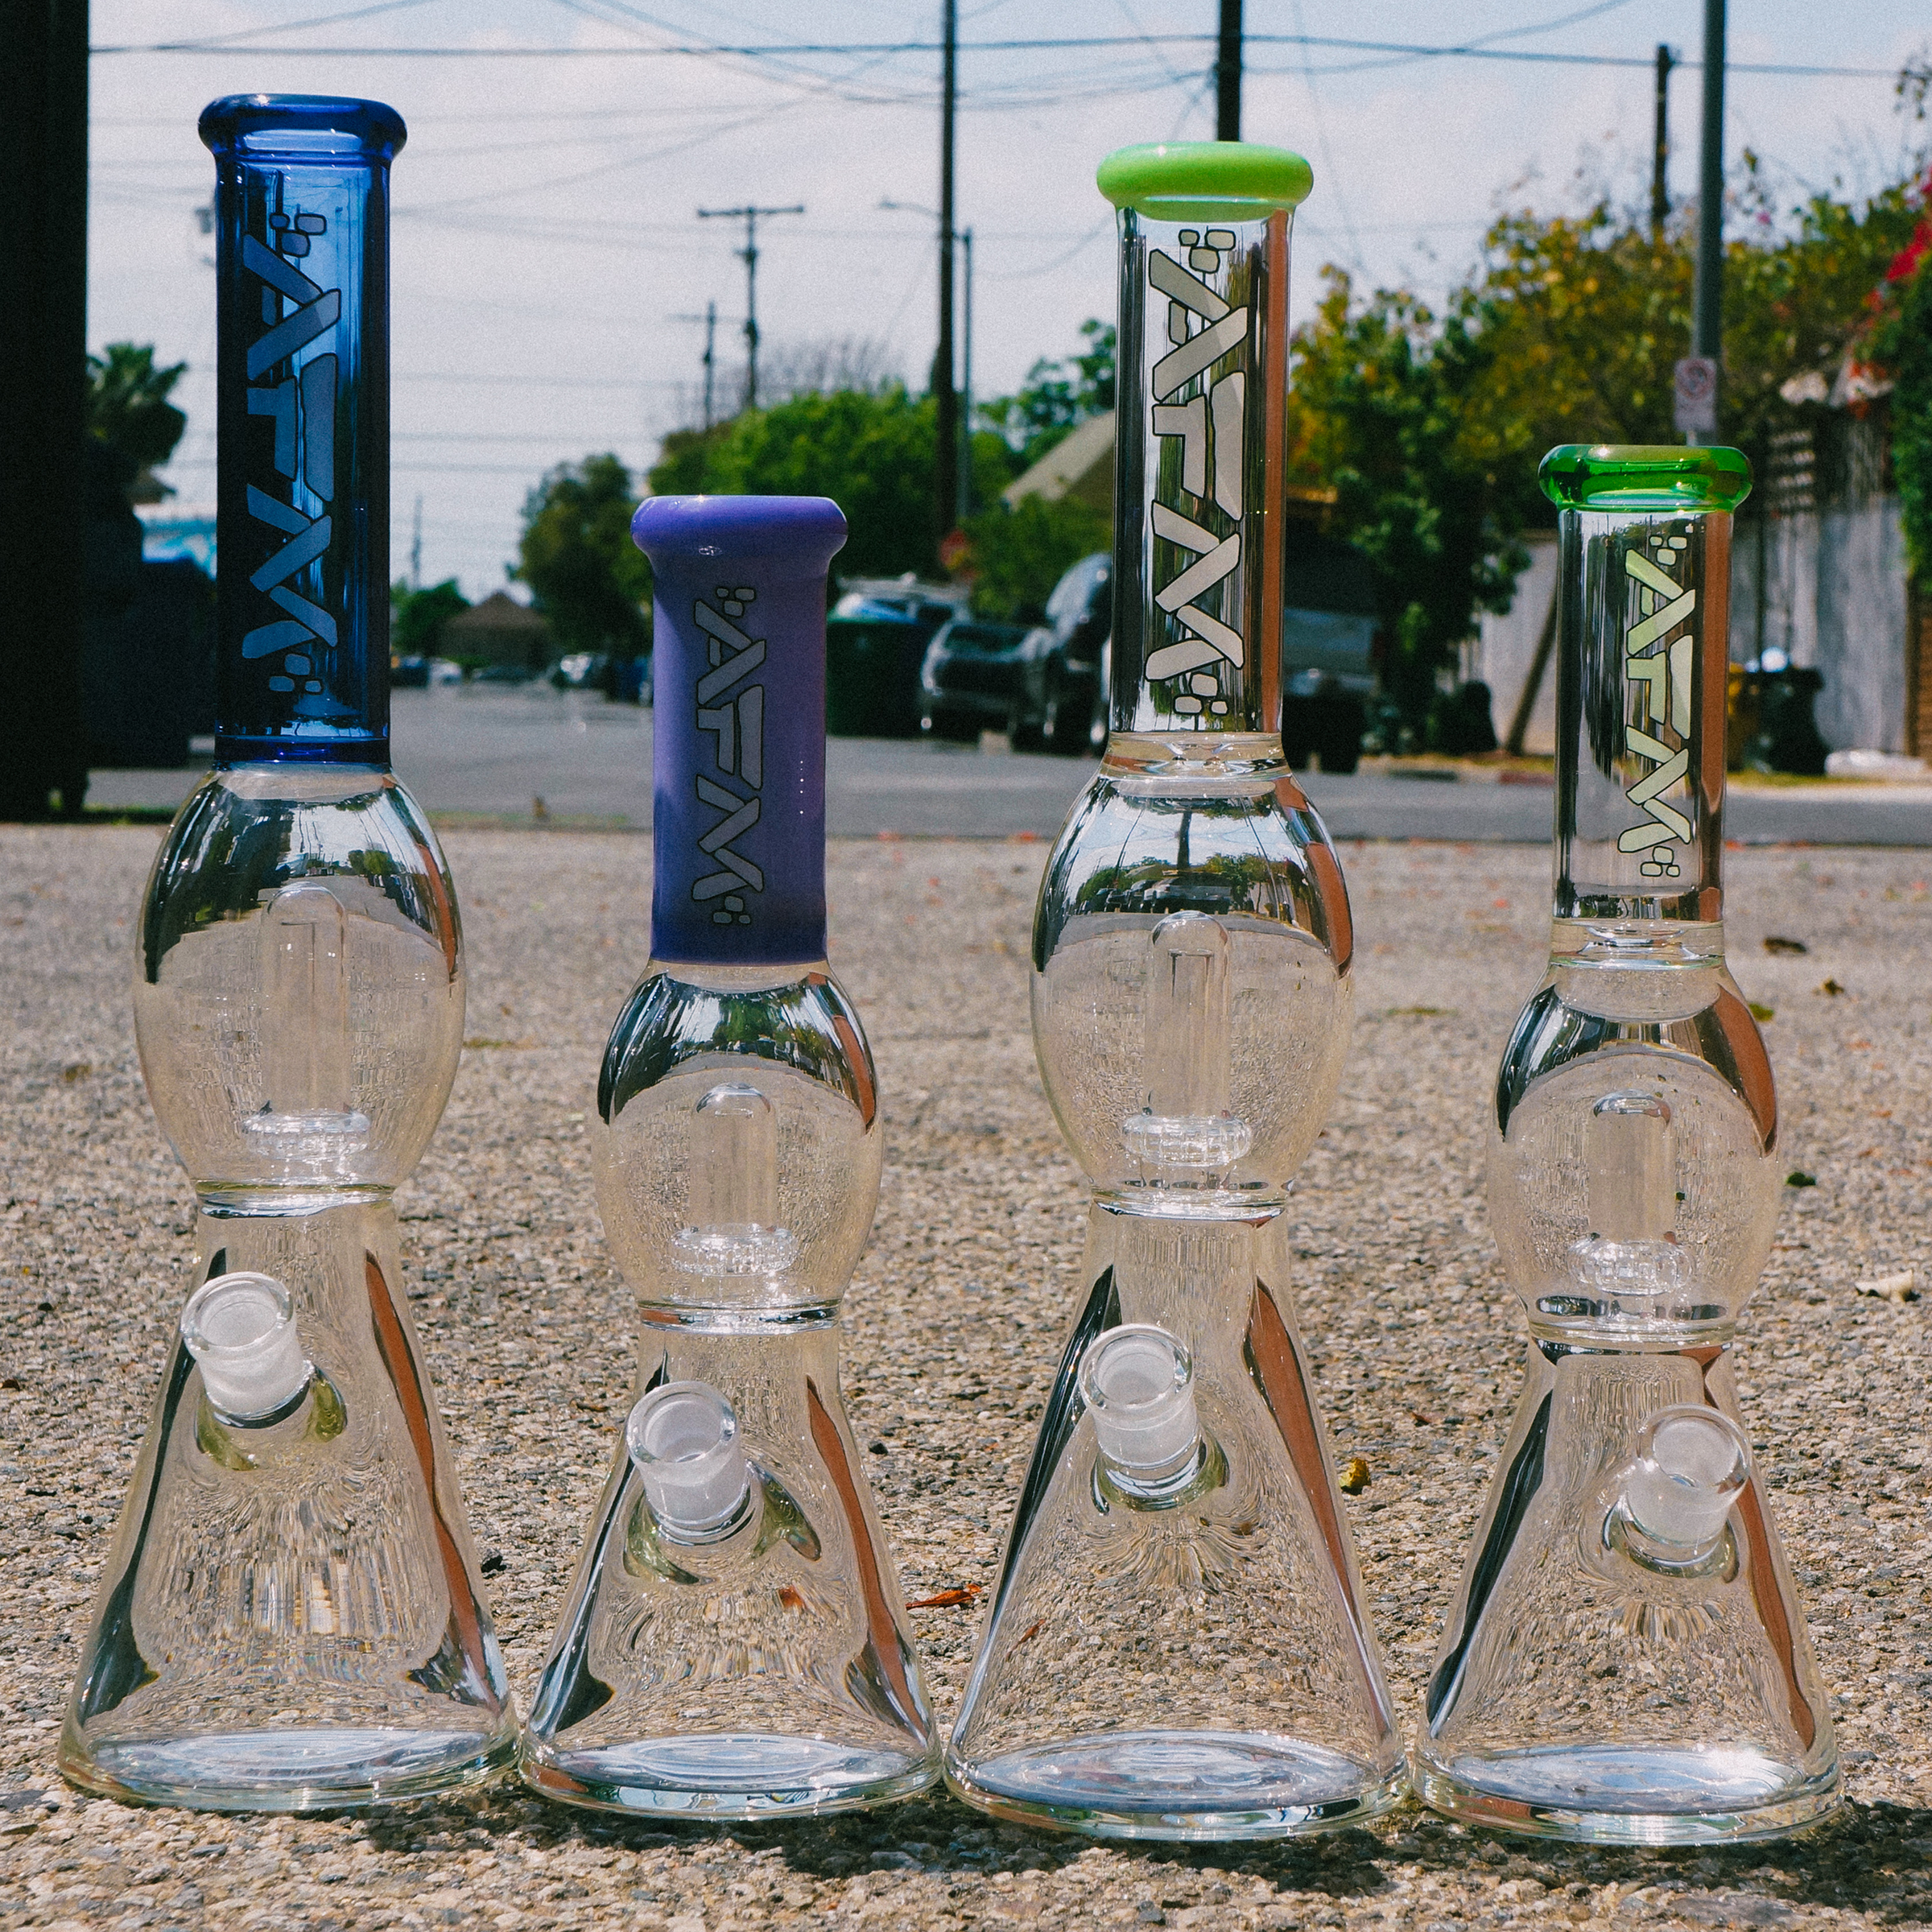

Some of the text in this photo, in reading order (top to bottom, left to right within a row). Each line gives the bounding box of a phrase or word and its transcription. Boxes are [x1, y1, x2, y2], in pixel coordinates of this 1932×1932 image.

[242, 233, 341, 659] AFM
[1145, 248, 1248, 682] AFM
[692, 599, 766, 902] AFM
[1617, 547, 1695, 853] AFM
